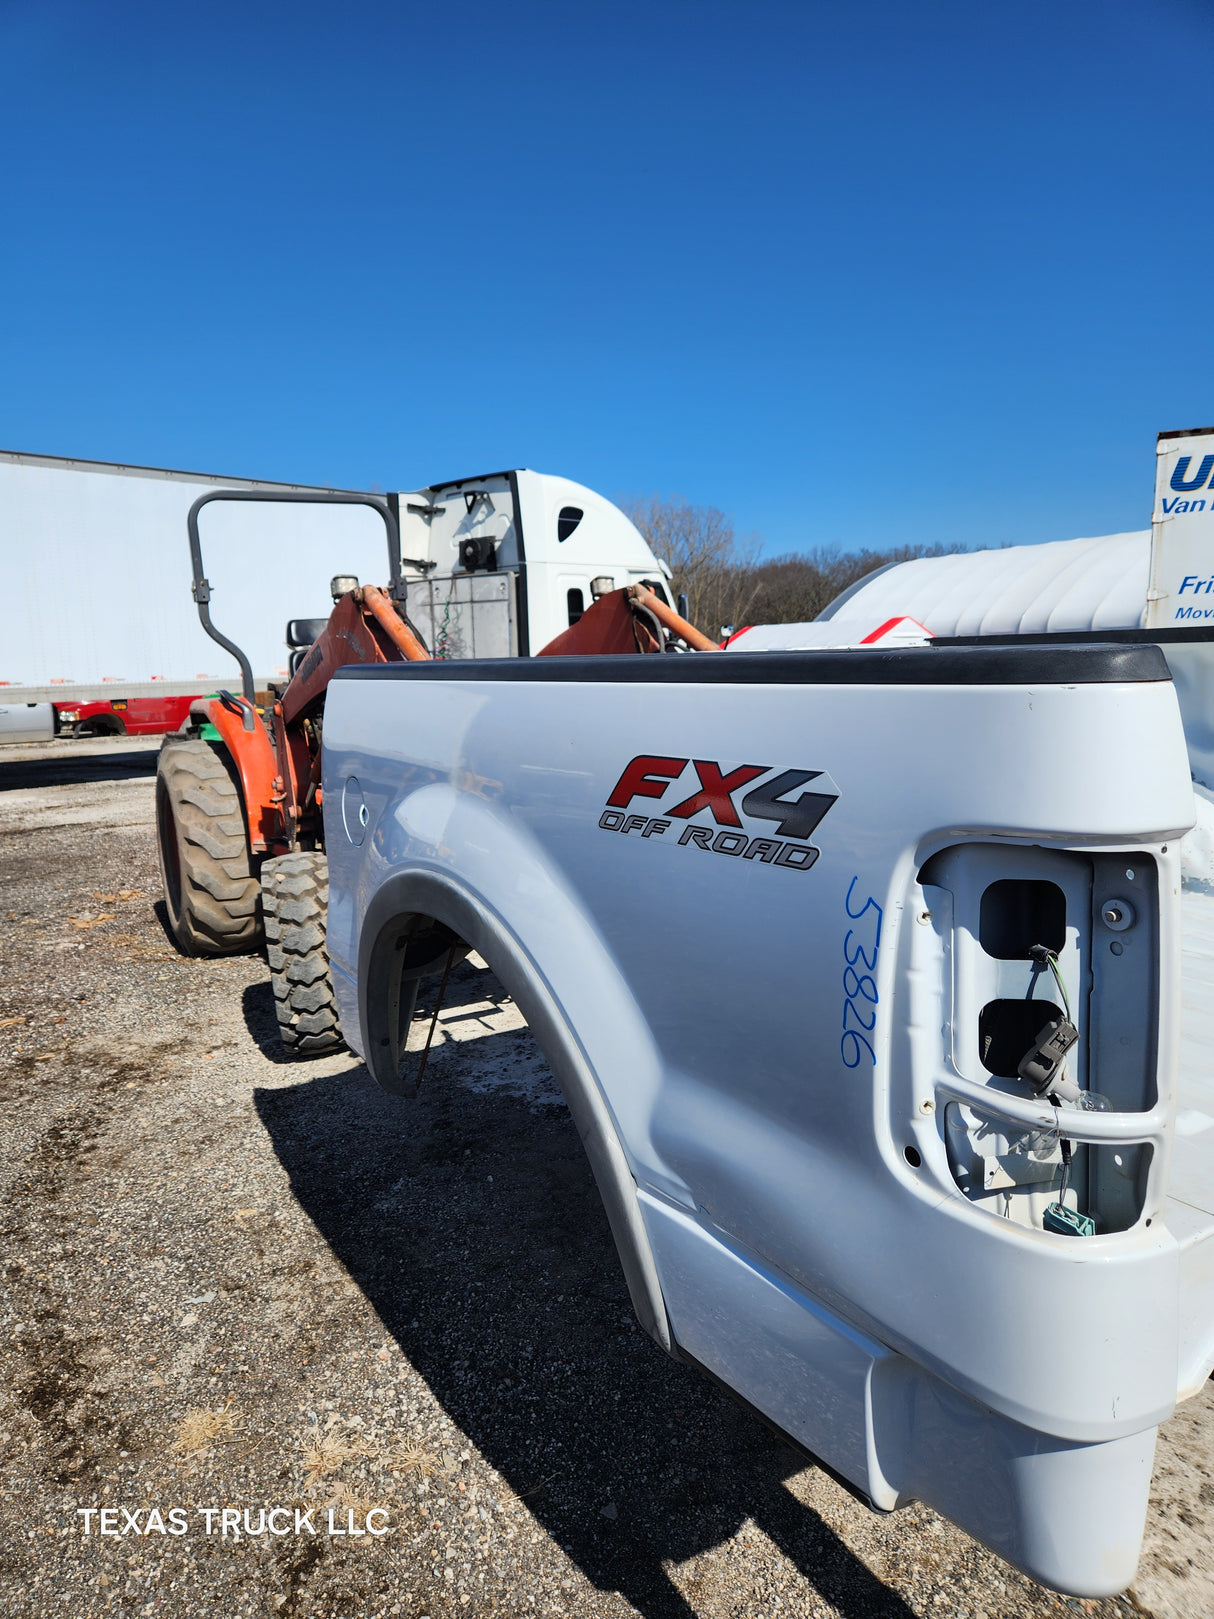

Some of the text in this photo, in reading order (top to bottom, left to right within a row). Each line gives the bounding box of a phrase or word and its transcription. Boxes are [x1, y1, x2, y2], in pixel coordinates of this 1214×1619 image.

[1170, 455, 1214, 492] U
[1162, 496, 1206, 514] Van
[1178, 575, 1214, 595] Fri
[1175, 606, 1214, 619] Mov
[605, 754, 840, 840] FX4
[599, 809, 821, 871] OFF ROAD
[841, 875, 883, 1069] 53826
